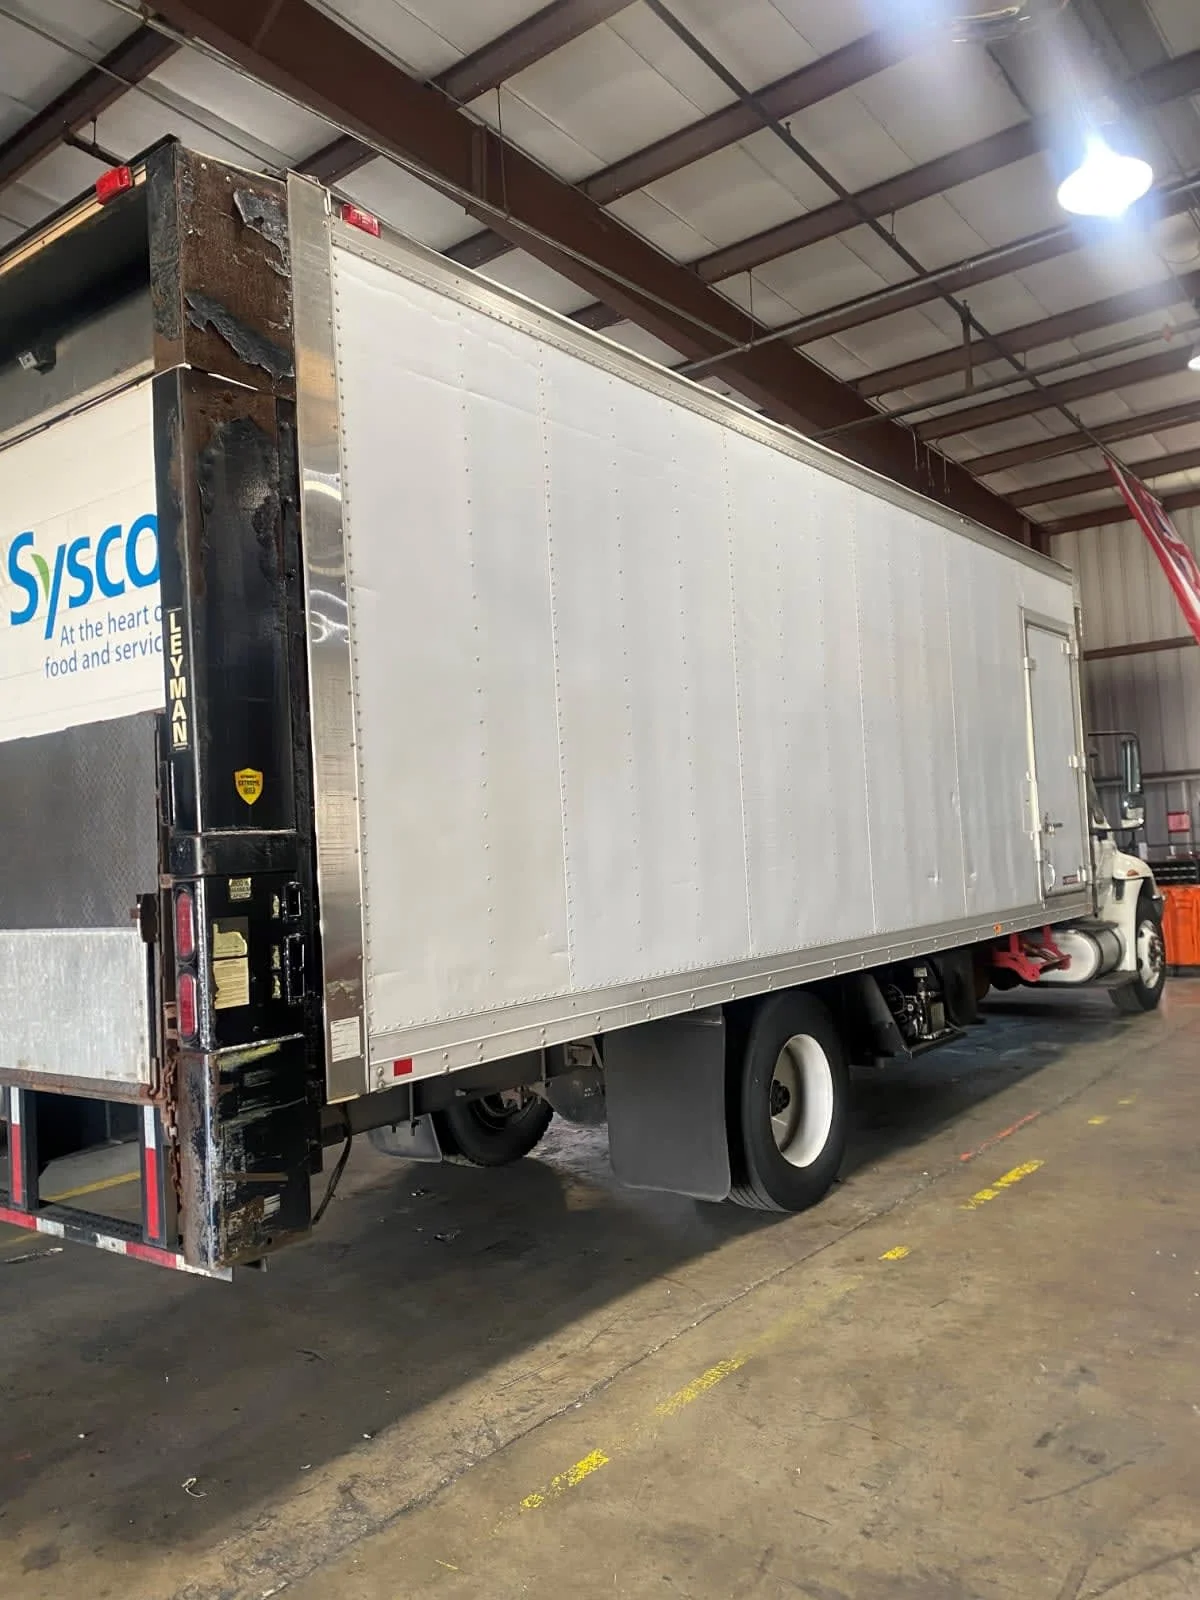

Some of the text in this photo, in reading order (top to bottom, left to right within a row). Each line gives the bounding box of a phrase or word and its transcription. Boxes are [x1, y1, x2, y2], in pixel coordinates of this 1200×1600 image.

[8, 514, 161, 640] Sysco
[45, 631, 162, 678] food and servic
[60, 605, 162, 647] At the heart o
[169, 612, 188, 744] LEYMAN
